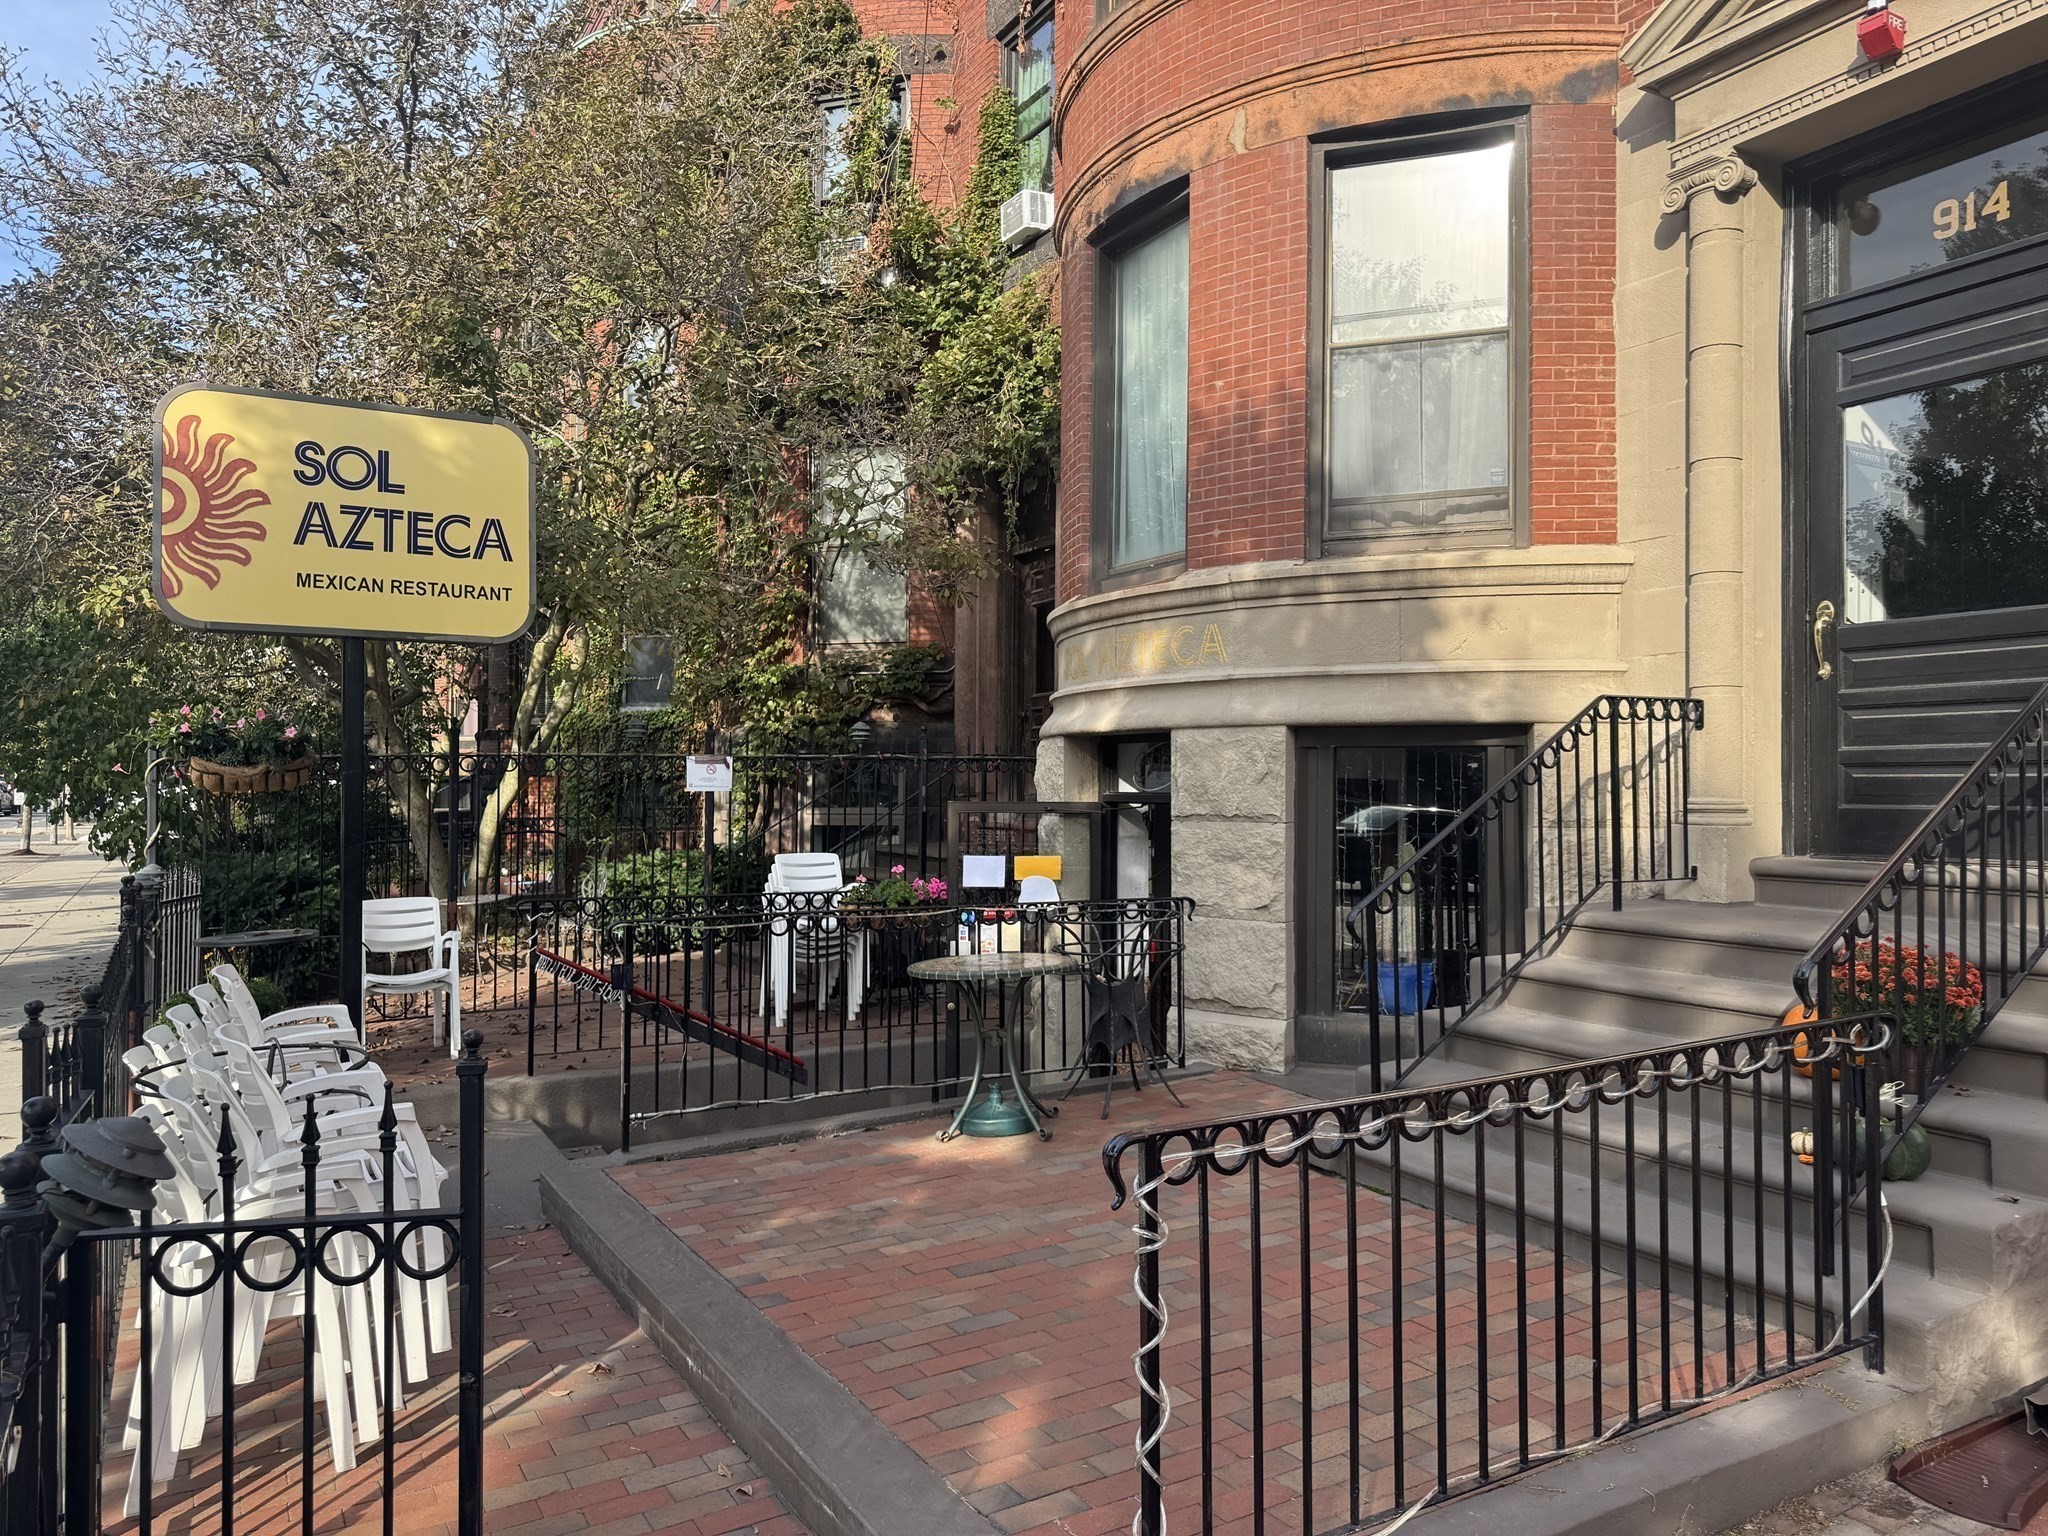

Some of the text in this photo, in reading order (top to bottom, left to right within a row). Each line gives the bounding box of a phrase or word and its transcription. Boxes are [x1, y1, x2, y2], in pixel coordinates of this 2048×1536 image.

[1932, 180, 2011, 240] 914
[293, 440, 406, 495] SOL
[293, 501, 513, 562] AZTECA
[296, 572, 513, 602] MEXICAN RESTAURANT
[1098, 623, 1229, 676] AZTECA
